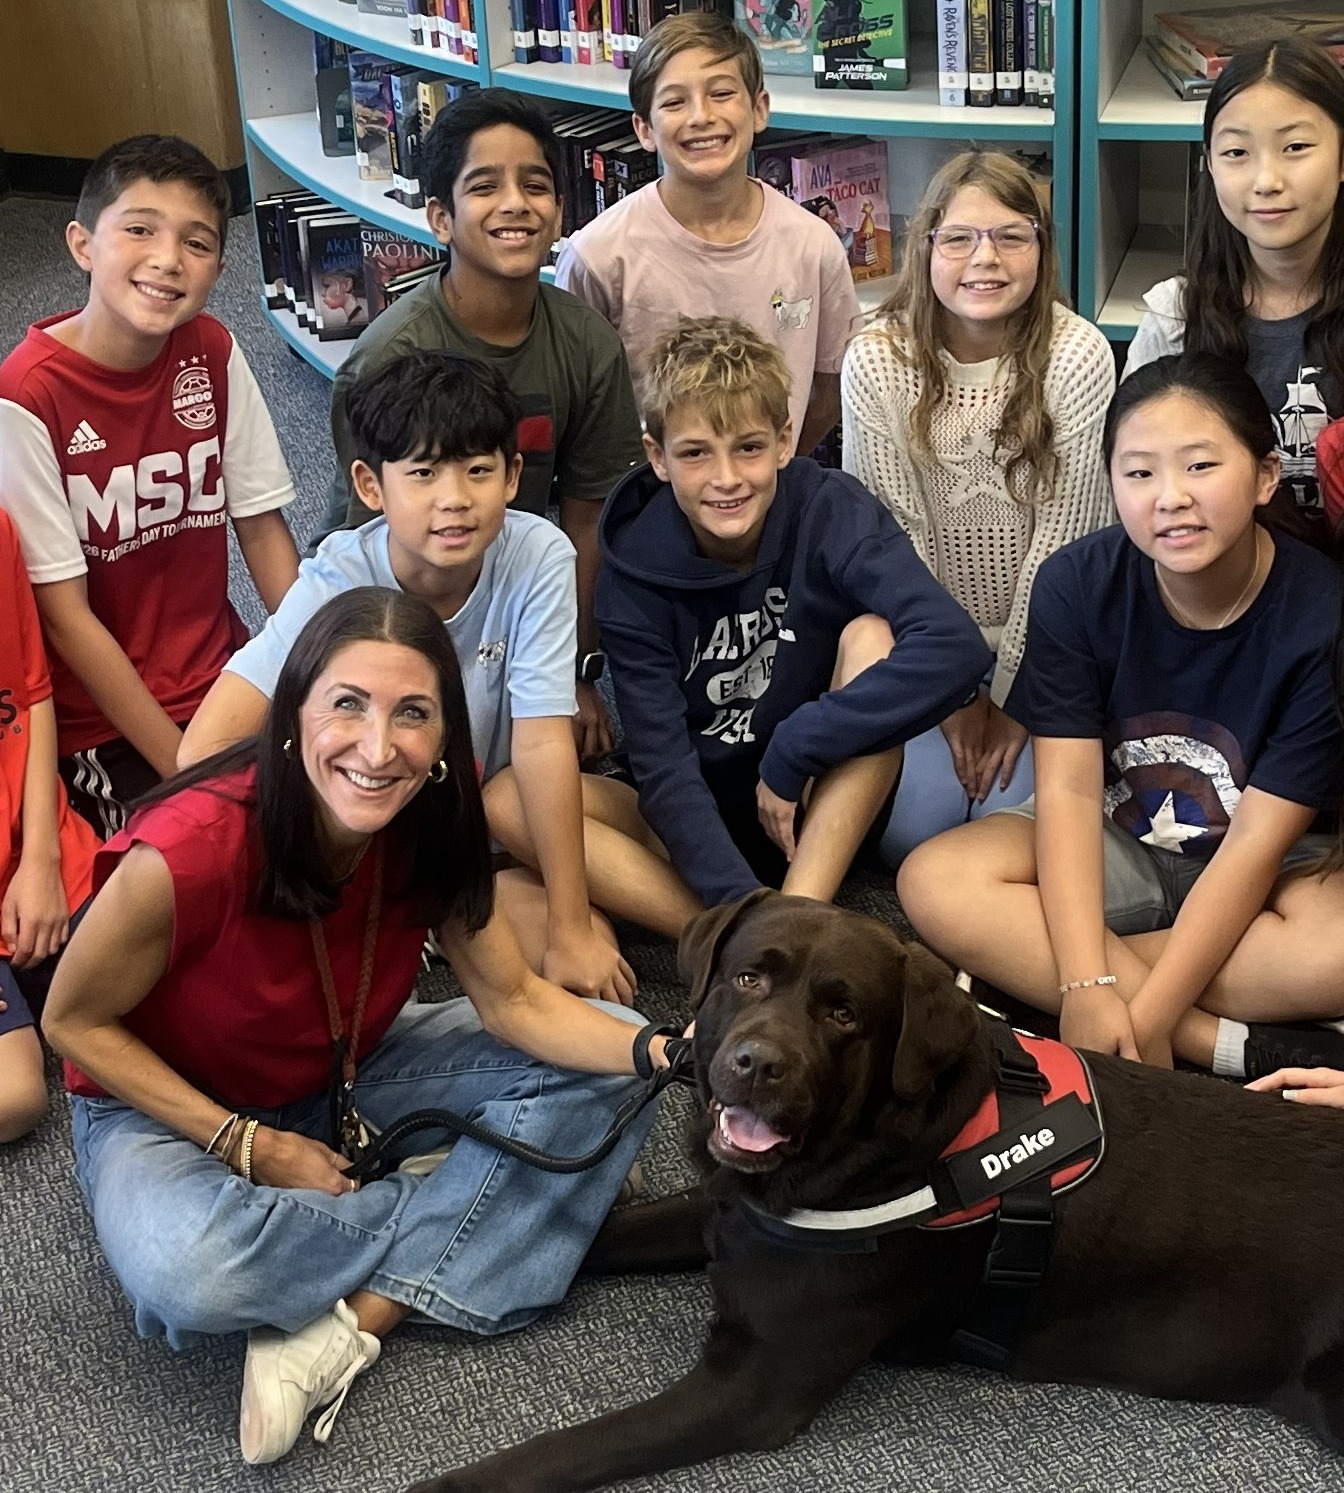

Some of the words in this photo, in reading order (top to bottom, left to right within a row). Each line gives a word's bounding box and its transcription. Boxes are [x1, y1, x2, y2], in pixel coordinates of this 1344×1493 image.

[943, 40, 957, 72] REVENG
[825, 71, 887, 82] PATTERSON
[838, 64, 873, 73] JAMES
[810, 164, 832, 190] AVA
[826, 184, 857, 202] TACO
[859, 177, 881, 196] CAT
[326, 237, 359, 254] AKAT
[362, 242, 441, 261] PAOLINI
[173, 391, 213, 408] MAROO
[67, 438, 107, 455] adidas
[66, 435, 226, 541] MSC
[141, 526, 161, 546] DAY
[980, 1127, 1056, 1180] Drake
